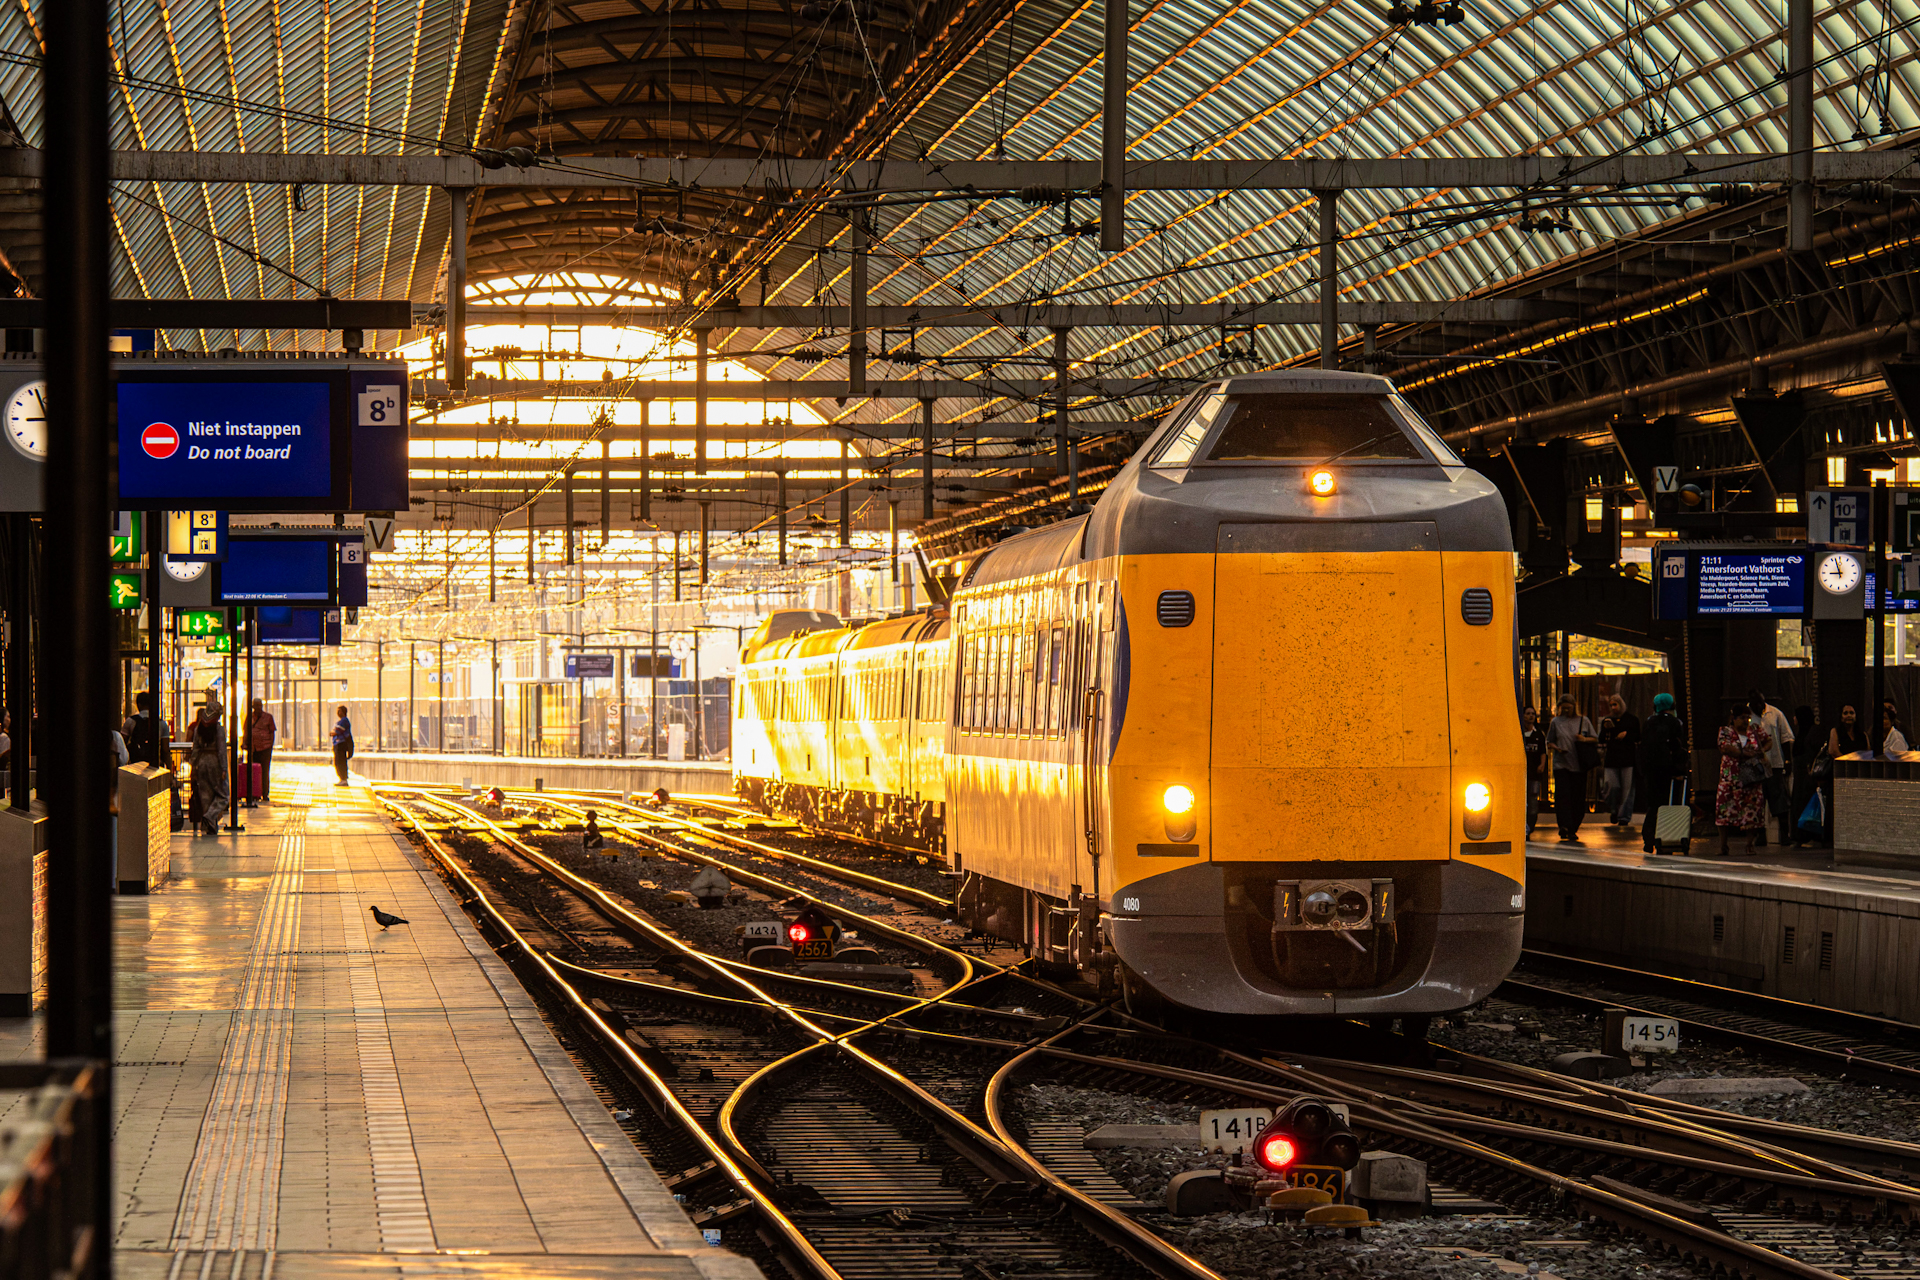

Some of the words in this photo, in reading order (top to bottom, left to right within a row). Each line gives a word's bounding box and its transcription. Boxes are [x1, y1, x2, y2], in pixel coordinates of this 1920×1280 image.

[370, 397, 395, 422] 8b
[188, 421, 221, 436] Niet
[225, 421, 301, 439] instappen
[188, 445, 210, 459] Do
[213, 446, 241, 459] not
[244, 444, 292, 459] board
[1658, 469, 1676, 490] V
[200, 513, 214, 526] 8a
[369, 520, 391, 549] V
[1701, 556, 1721, 564] 21:11
[1760, 556, 1785, 564] Sprinter
[1700, 564, 1748, 573] Amersfoort
[1749, 564, 1784, 573] Vathorst
[347, 612, 357, 625] V
[1123, 897, 1140, 911] 4080
[797, 942, 828, 956] 2562
[1629, 1023, 1676, 1041] 145A
[1211, 1117, 1266, 1140] 141B
